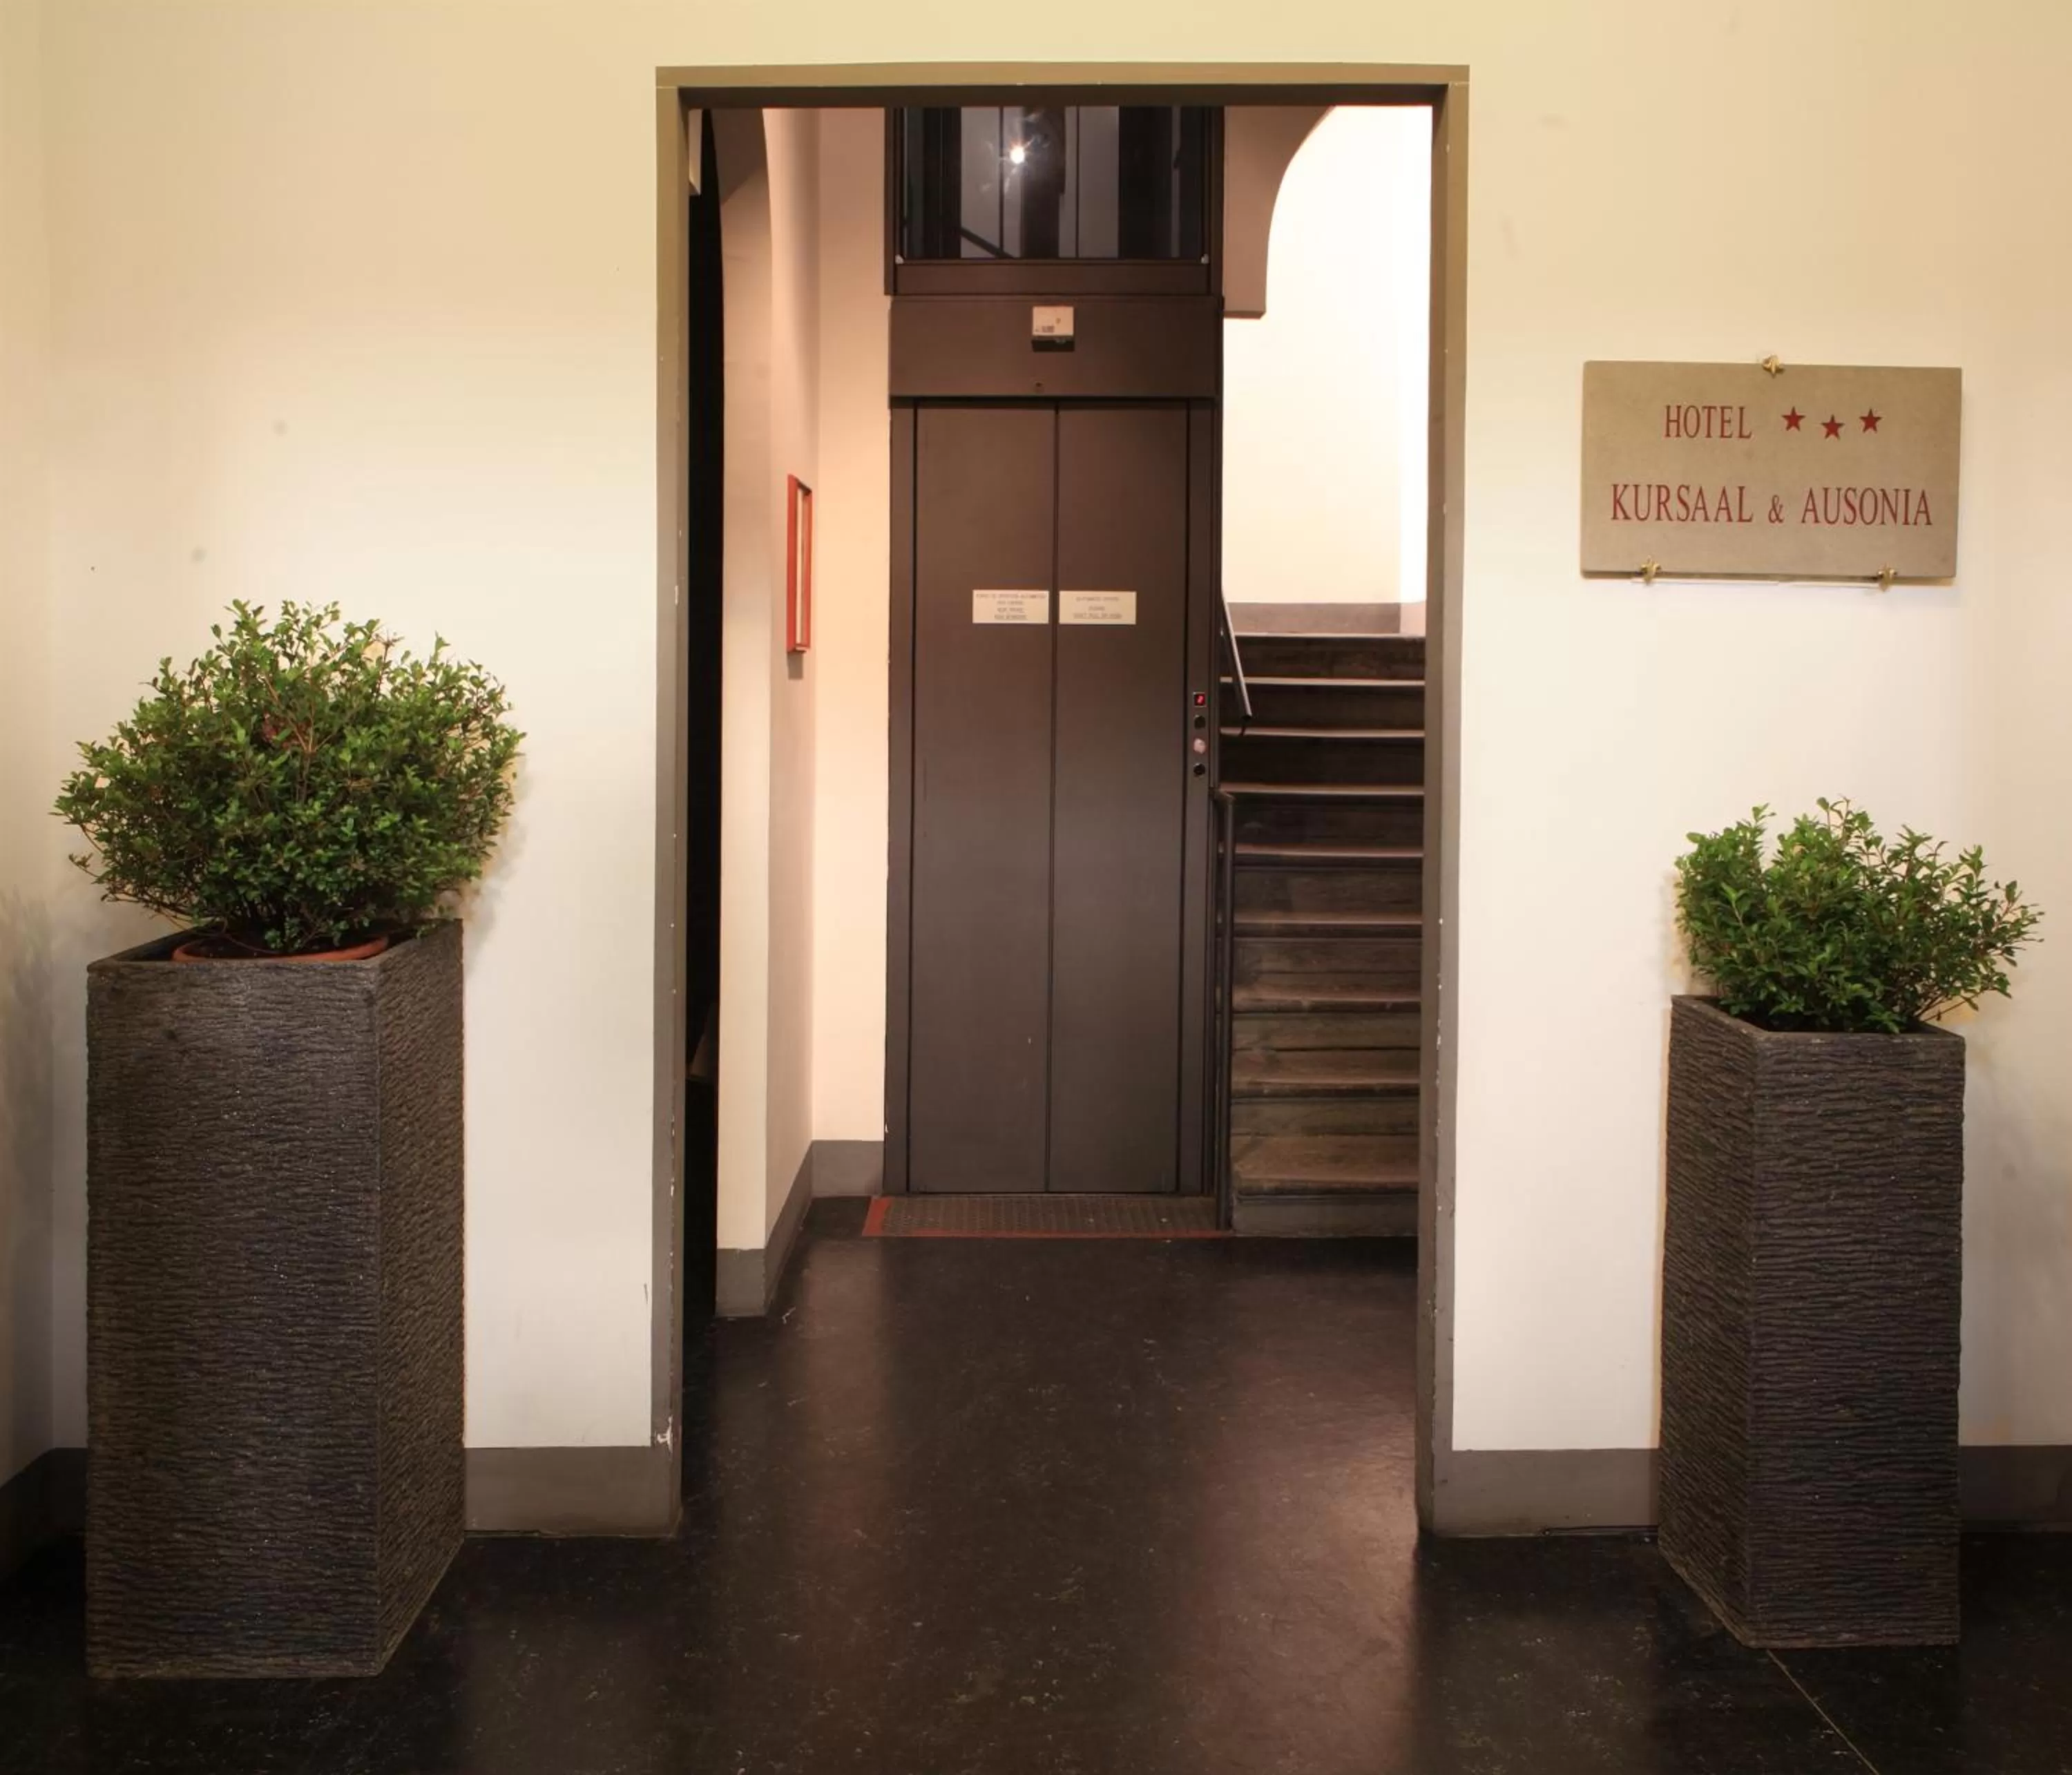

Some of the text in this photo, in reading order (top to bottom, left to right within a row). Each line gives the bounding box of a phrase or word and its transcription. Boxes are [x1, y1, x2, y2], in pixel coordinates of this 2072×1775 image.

[1664, 405, 1752, 439] HOTEL
[1611, 484, 1932, 526] KURSAAL & AUSONIA
